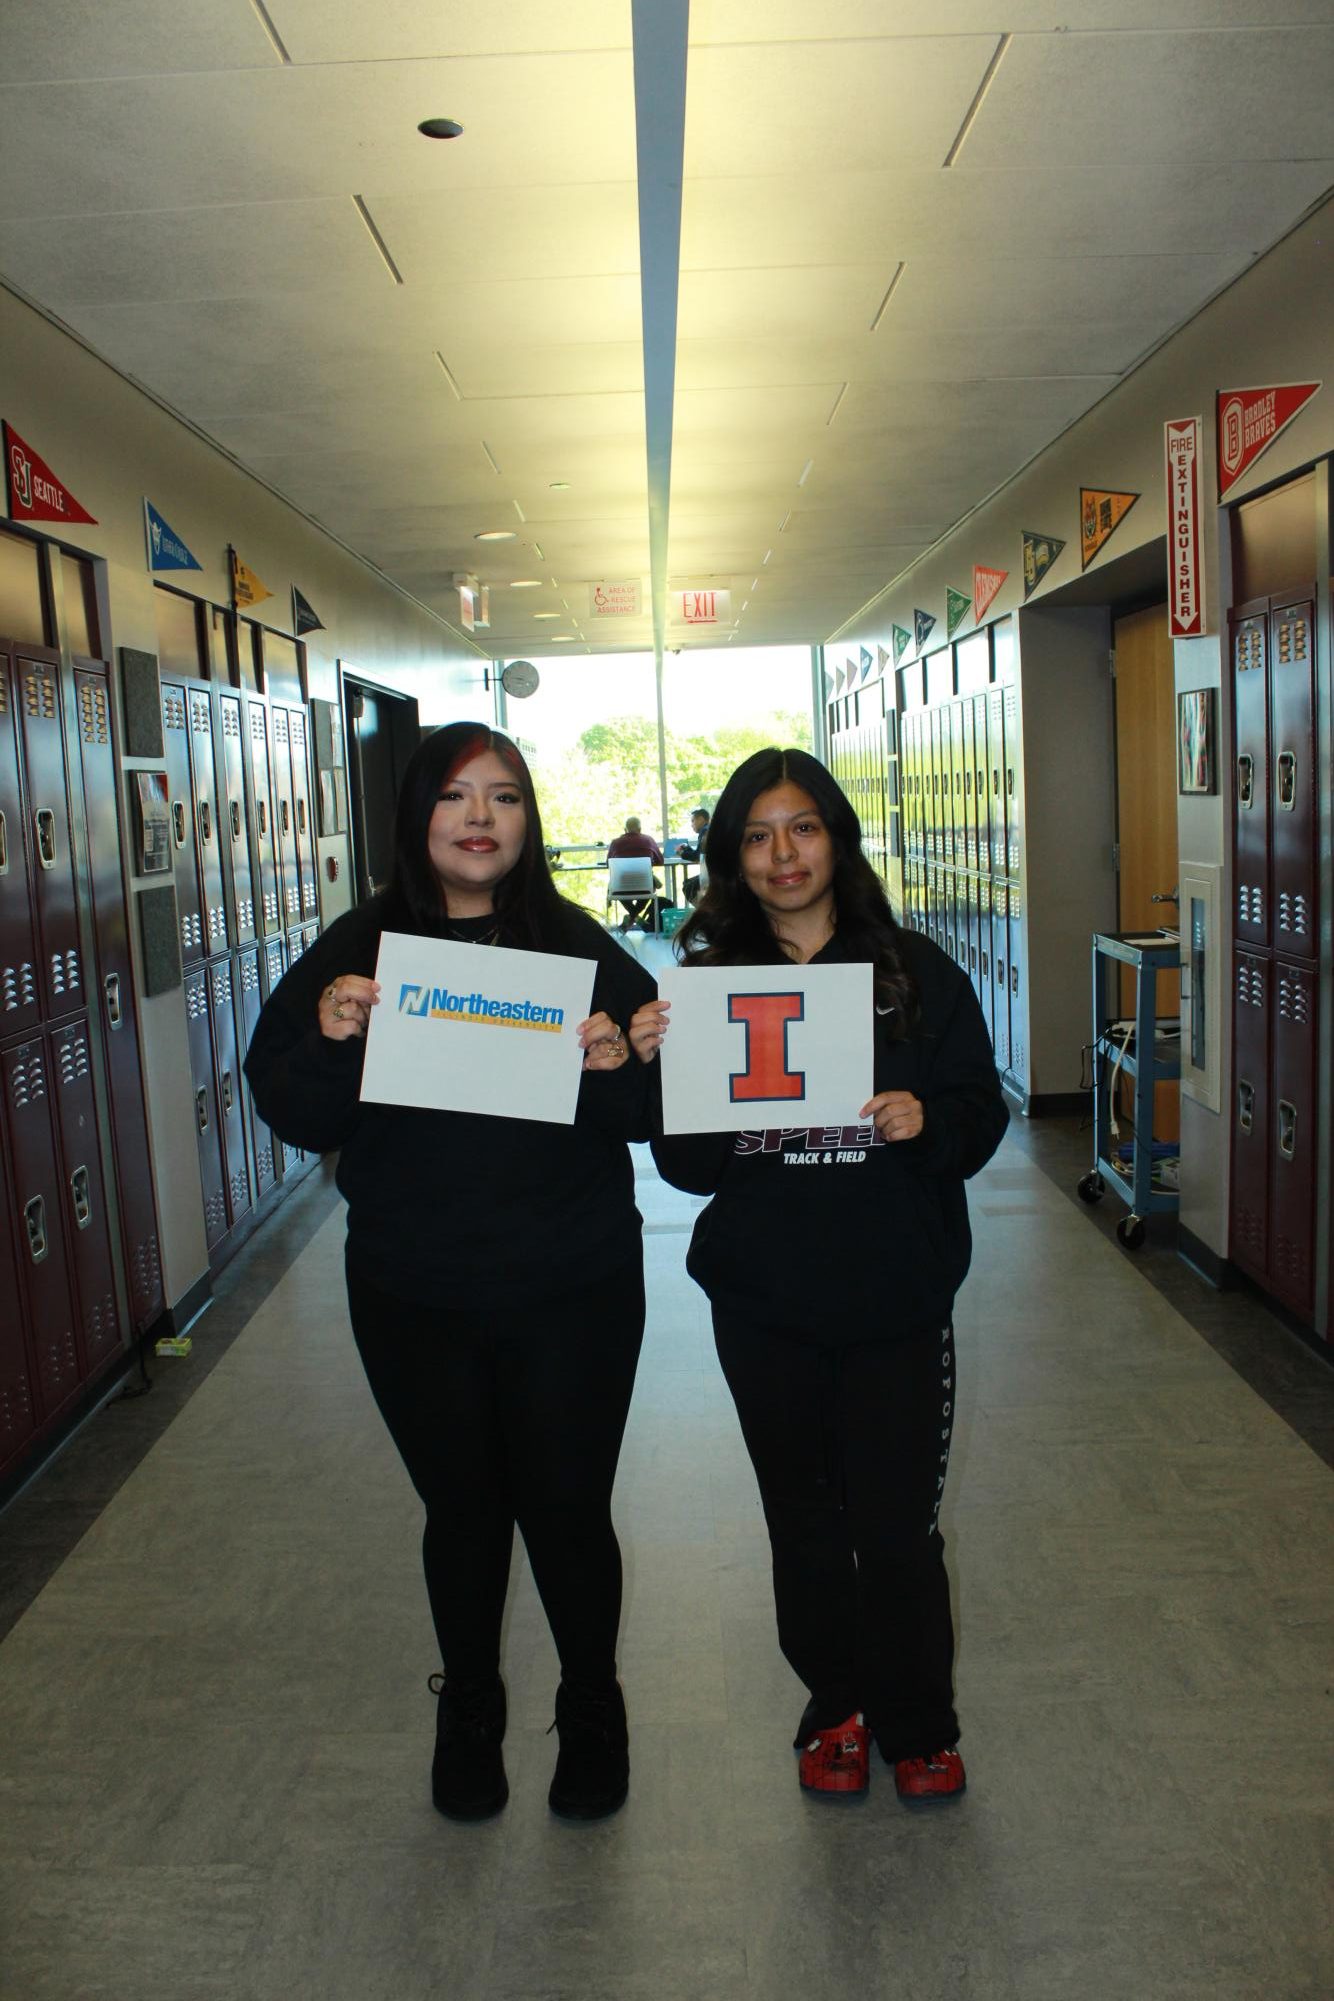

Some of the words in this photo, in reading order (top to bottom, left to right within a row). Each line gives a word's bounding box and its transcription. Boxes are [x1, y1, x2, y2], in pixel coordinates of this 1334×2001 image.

[1244, 390, 1276, 427] BRADLEY
[1170, 437, 1193, 454] FIRE
[1244, 412, 1276, 449] BRAVES
[33, 476, 64, 512] SEATTLE
[1177, 454, 1191, 618] EXTINGUISHER
[683, 592, 718, 618] EXIT
[431, 988, 564, 1025] Northeastern
[727, 991, 806, 1103] I
[734, 1125, 886, 1155] SPEE
[784, 1152, 821, 1165] TRACK
[823, 1152, 832, 1164] &
[836, 1151, 867, 1164] FIELD
